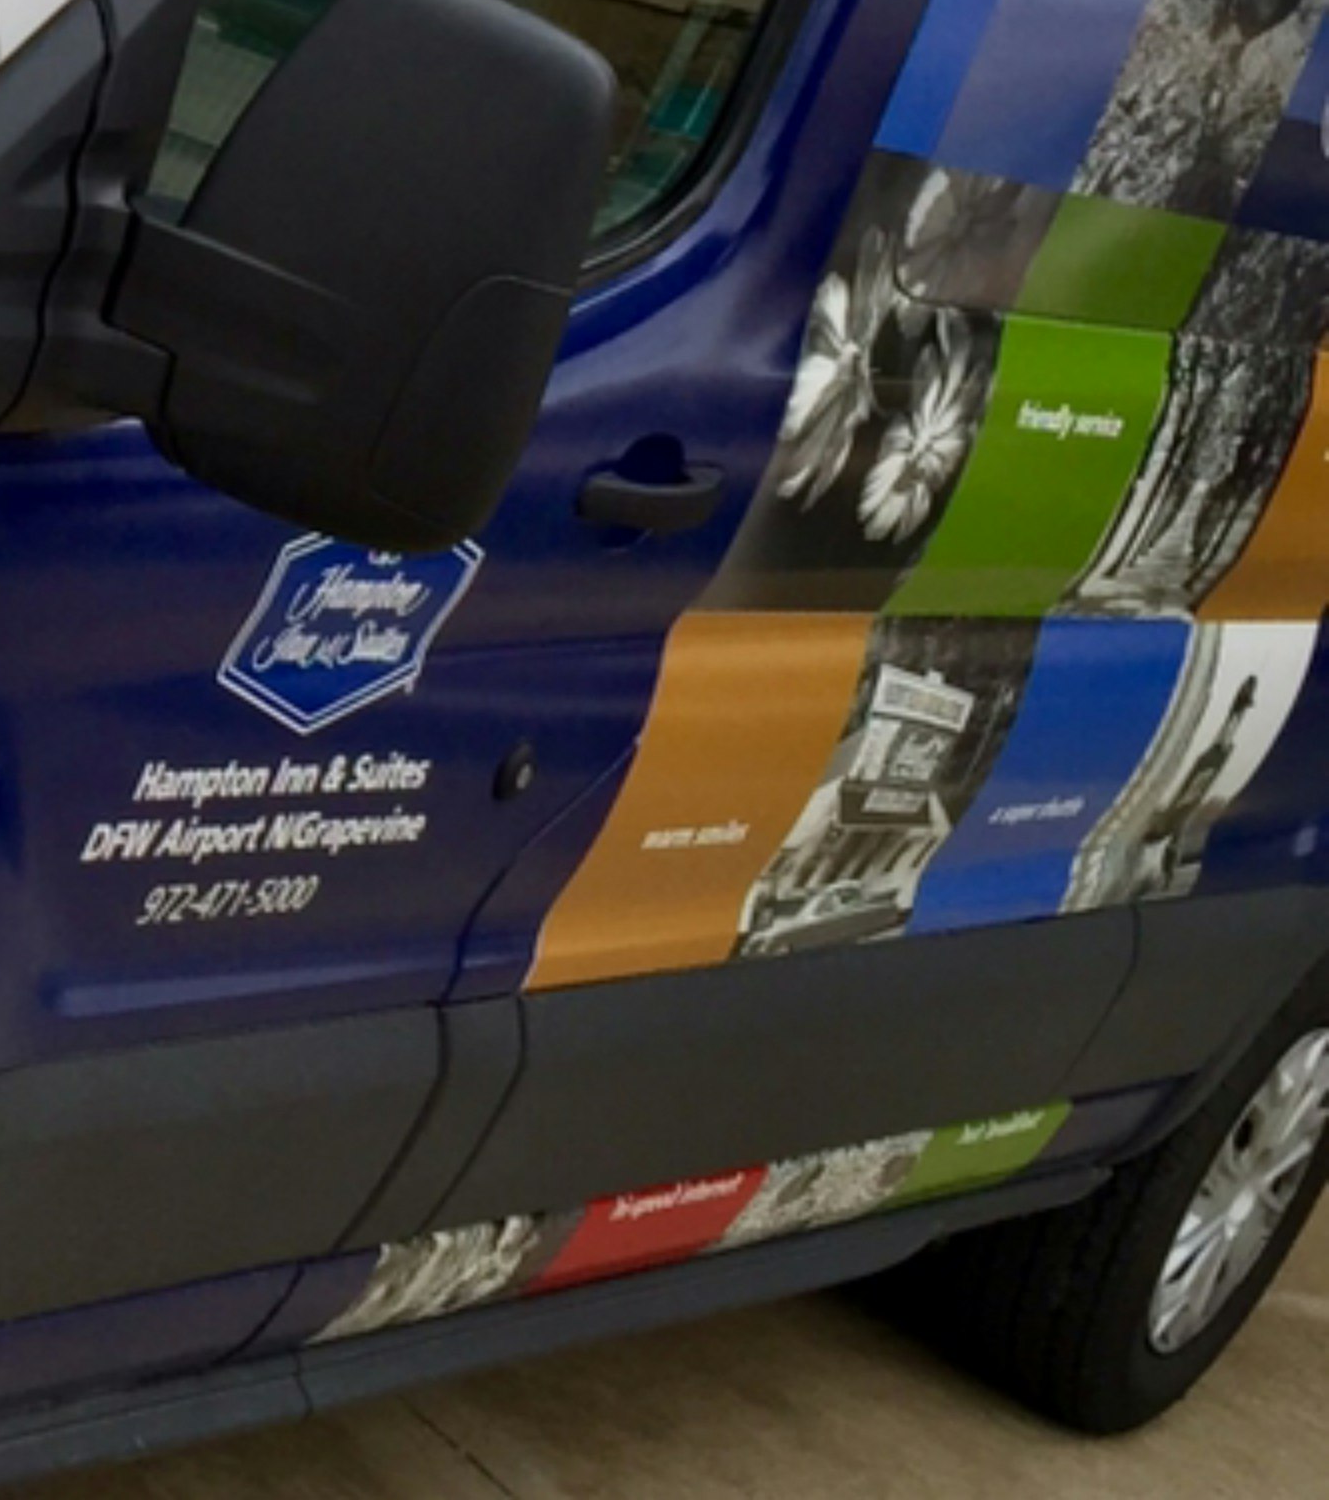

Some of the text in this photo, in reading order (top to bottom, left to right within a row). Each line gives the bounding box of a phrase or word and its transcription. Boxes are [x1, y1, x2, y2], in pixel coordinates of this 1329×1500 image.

[285, 563, 432, 621] Hampton
[132, 751, 432, 808] Hampton Inn & Suites
[80, 820, 162, 862] DFW
[153, 815, 266, 865] Airport
[135, 874, 321, 927] 972-471-5000
